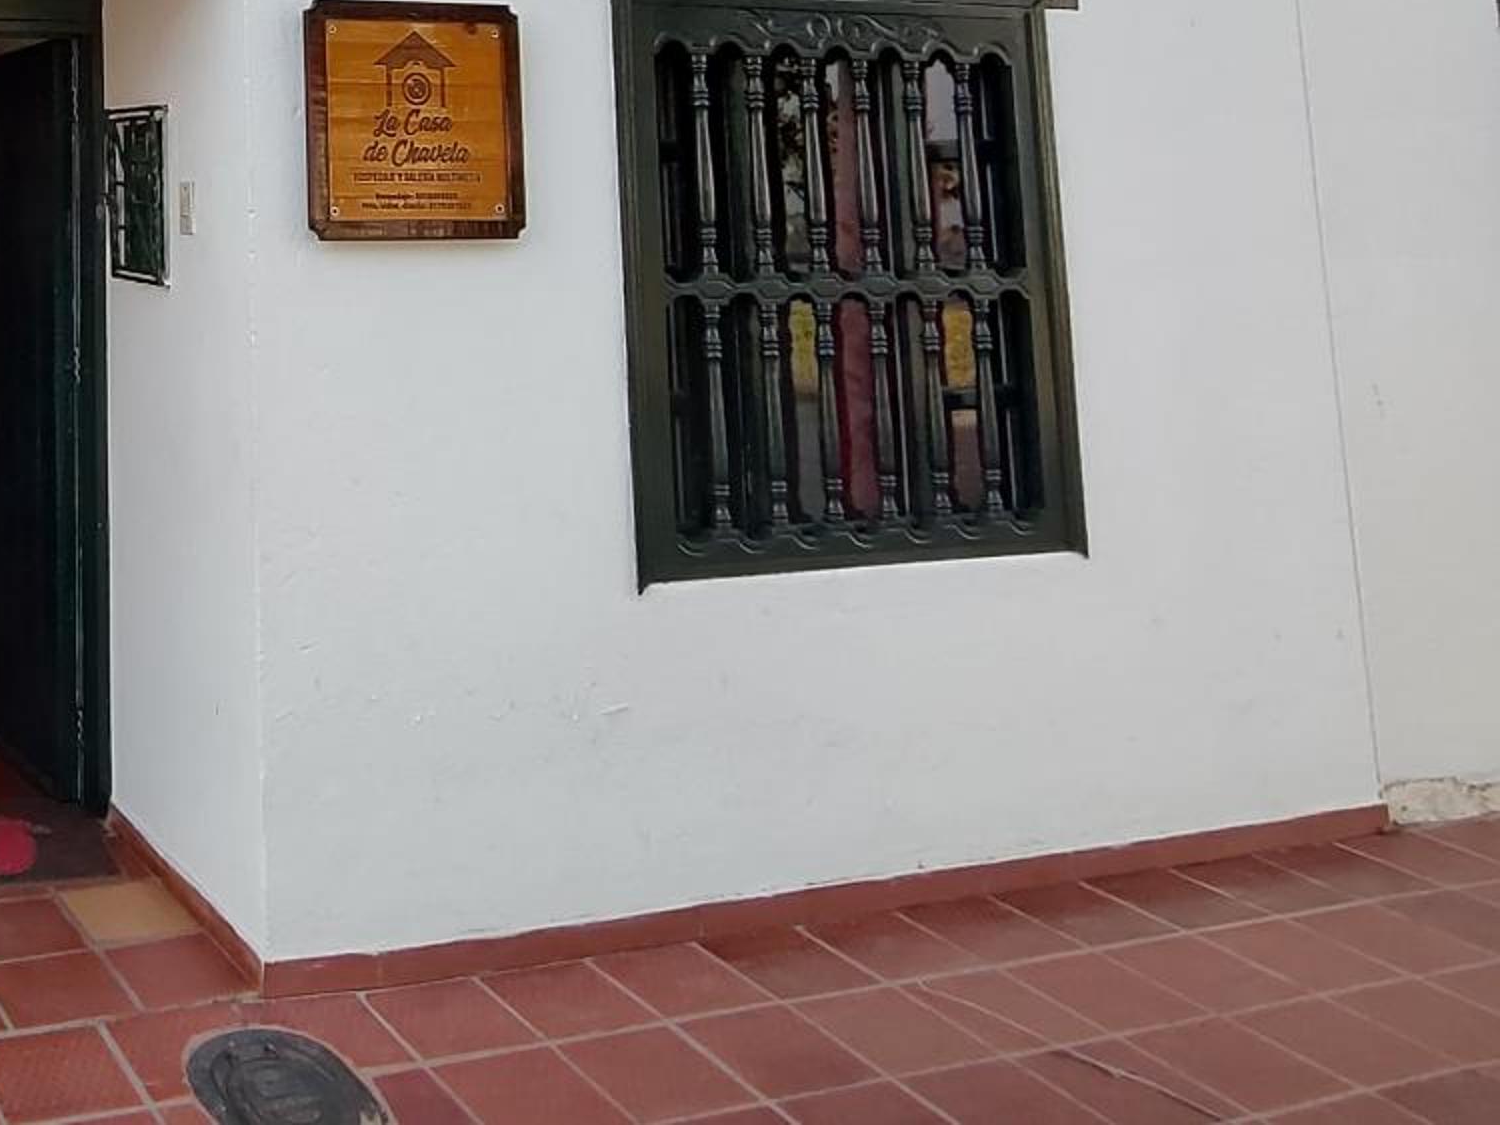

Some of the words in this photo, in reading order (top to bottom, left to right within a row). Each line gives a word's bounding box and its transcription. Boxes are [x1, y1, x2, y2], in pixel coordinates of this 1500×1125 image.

[373, 108, 399, 137] La
[403, 108, 452, 136] Casa
[363, 140, 389, 162] de
[391, 138, 469, 167] Chavela
